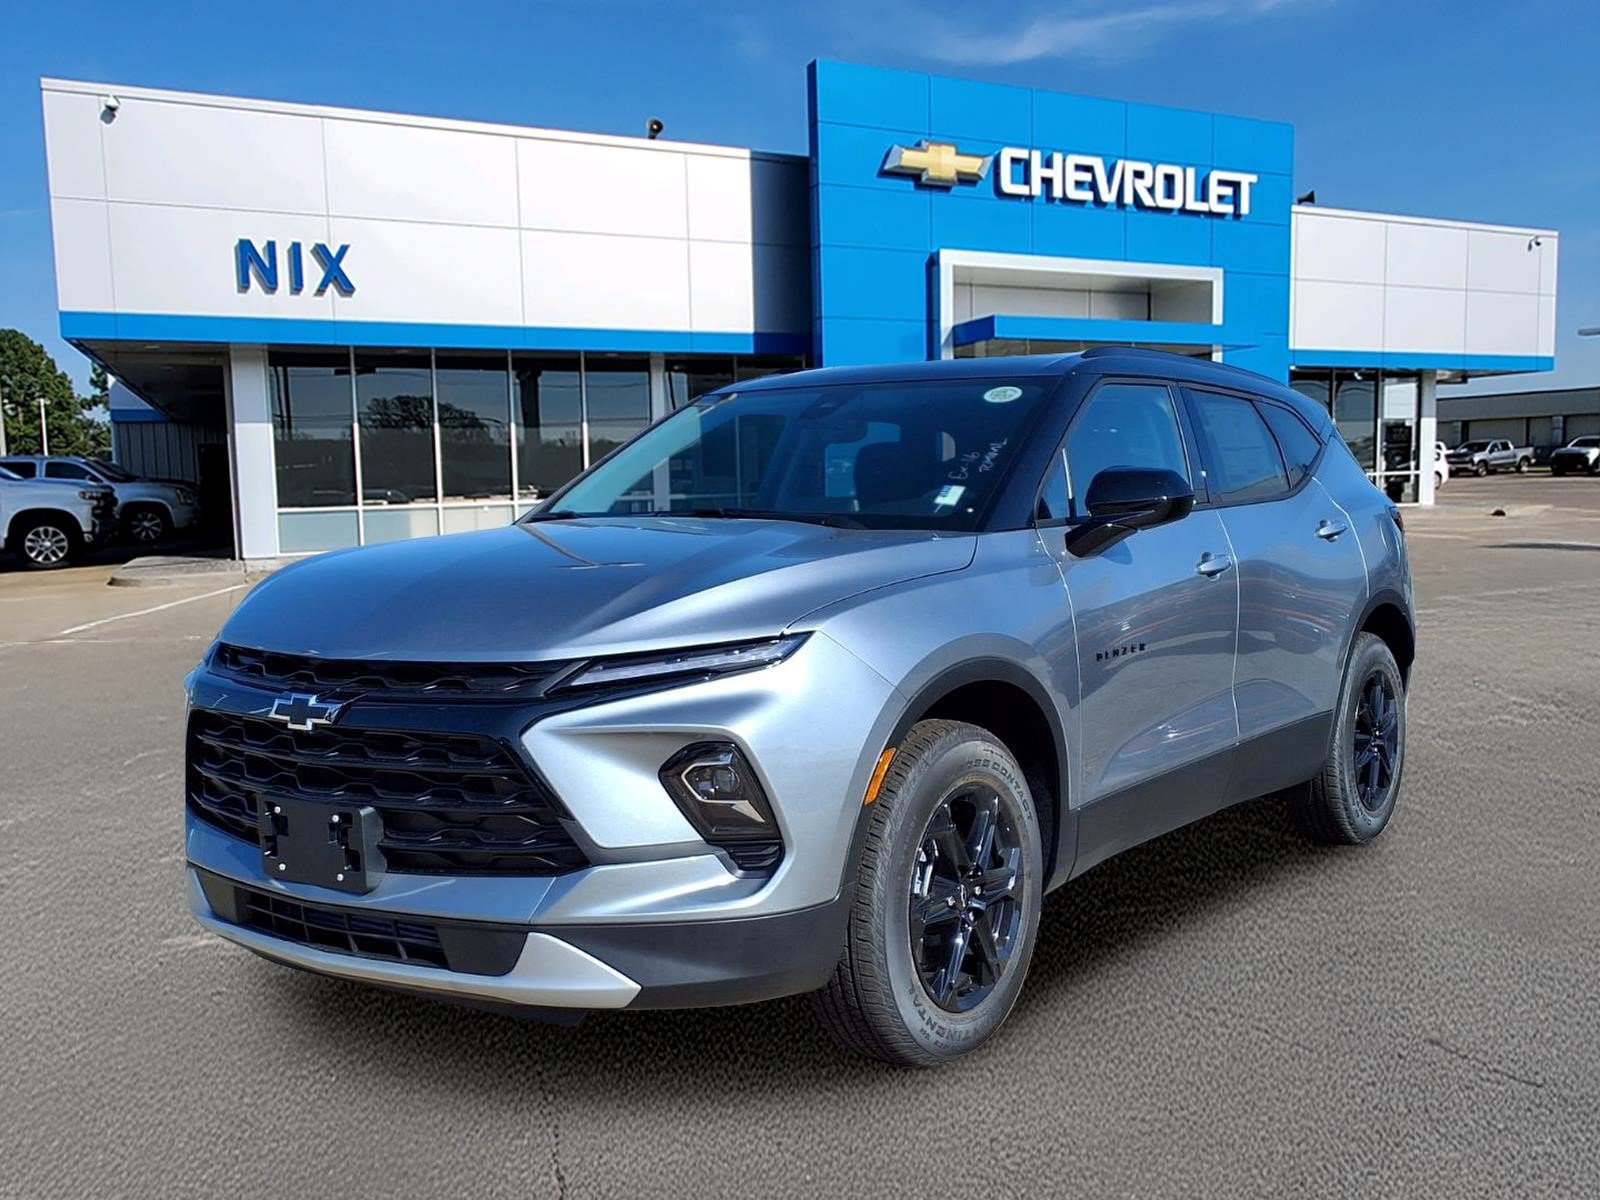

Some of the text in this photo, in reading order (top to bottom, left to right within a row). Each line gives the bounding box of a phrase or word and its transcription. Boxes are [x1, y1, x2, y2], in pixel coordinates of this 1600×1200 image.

[1000, 146, 1259, 216] CHEVROLET
[235, 238, 356, 297] NIX
[1095, 642, 1147, 662] BLAZER
